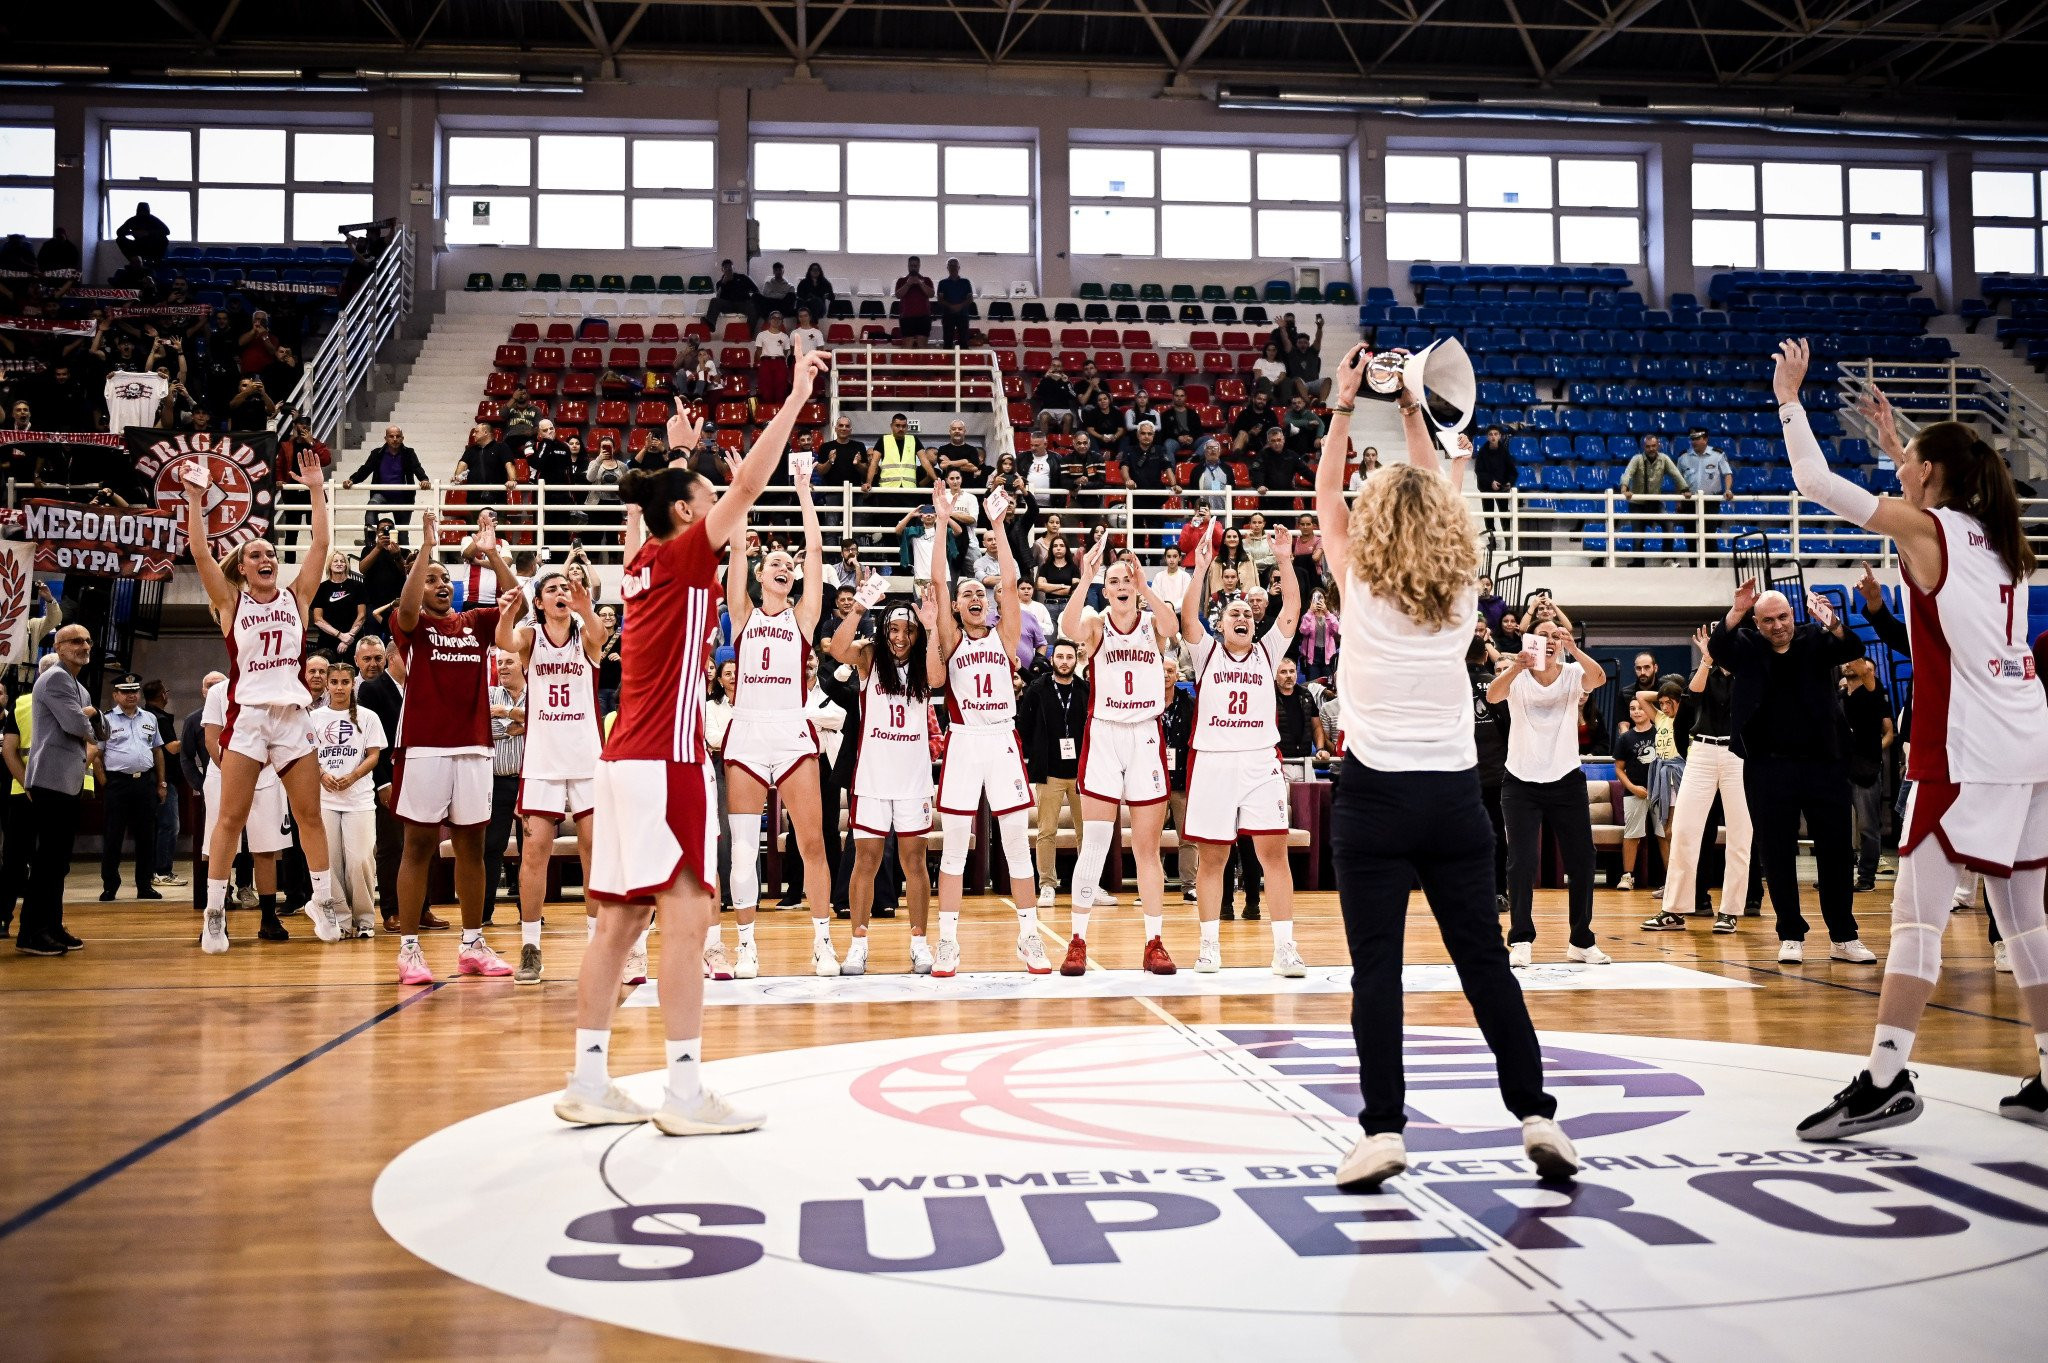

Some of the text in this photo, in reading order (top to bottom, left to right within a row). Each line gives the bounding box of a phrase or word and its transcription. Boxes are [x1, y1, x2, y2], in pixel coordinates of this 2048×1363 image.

[135, 432, 270, 482] BRIGADE
[24, 504, 178, 554] ΜΕΣΟΛΟΓΓΙ
[56, 547, 144, 573] ΘΥΡΑ 7
[1999, 584, 2014, 647] 7
[259, 630, 283, 656] 77
[428, 633, 480, 648] OLYMPIACOS
[248, 658, 298, 673] Stoiximan
[430, 649, 481, 662] Stoiximan
[761, 646, 770, 671] 9
[742, 672, 792, 685] toiximan
[974, 673, 992, 698] 14
[1124, 670, 1133, 695] 8
[1213, 671, 1263, 686] OLYMPIACOS
[548, 683, 570, 708] 55
[961, 698, 1009, 711] Stoiximan
[1105, 697, 1156, 709] Stoiximan
[1228, 690, 1248, 715] 23
[538, 709, 586, 721] Stoiximan
[889, 704, 905, 728] 13
[1208, 715, 1264, 728] Stoiximan
[870, 727, 921, 741] Stoiximan
[342, 748, 357, 757] CUP
[857, 1147, 1919, 1192] WOMEN'S BAKETALL 2025
